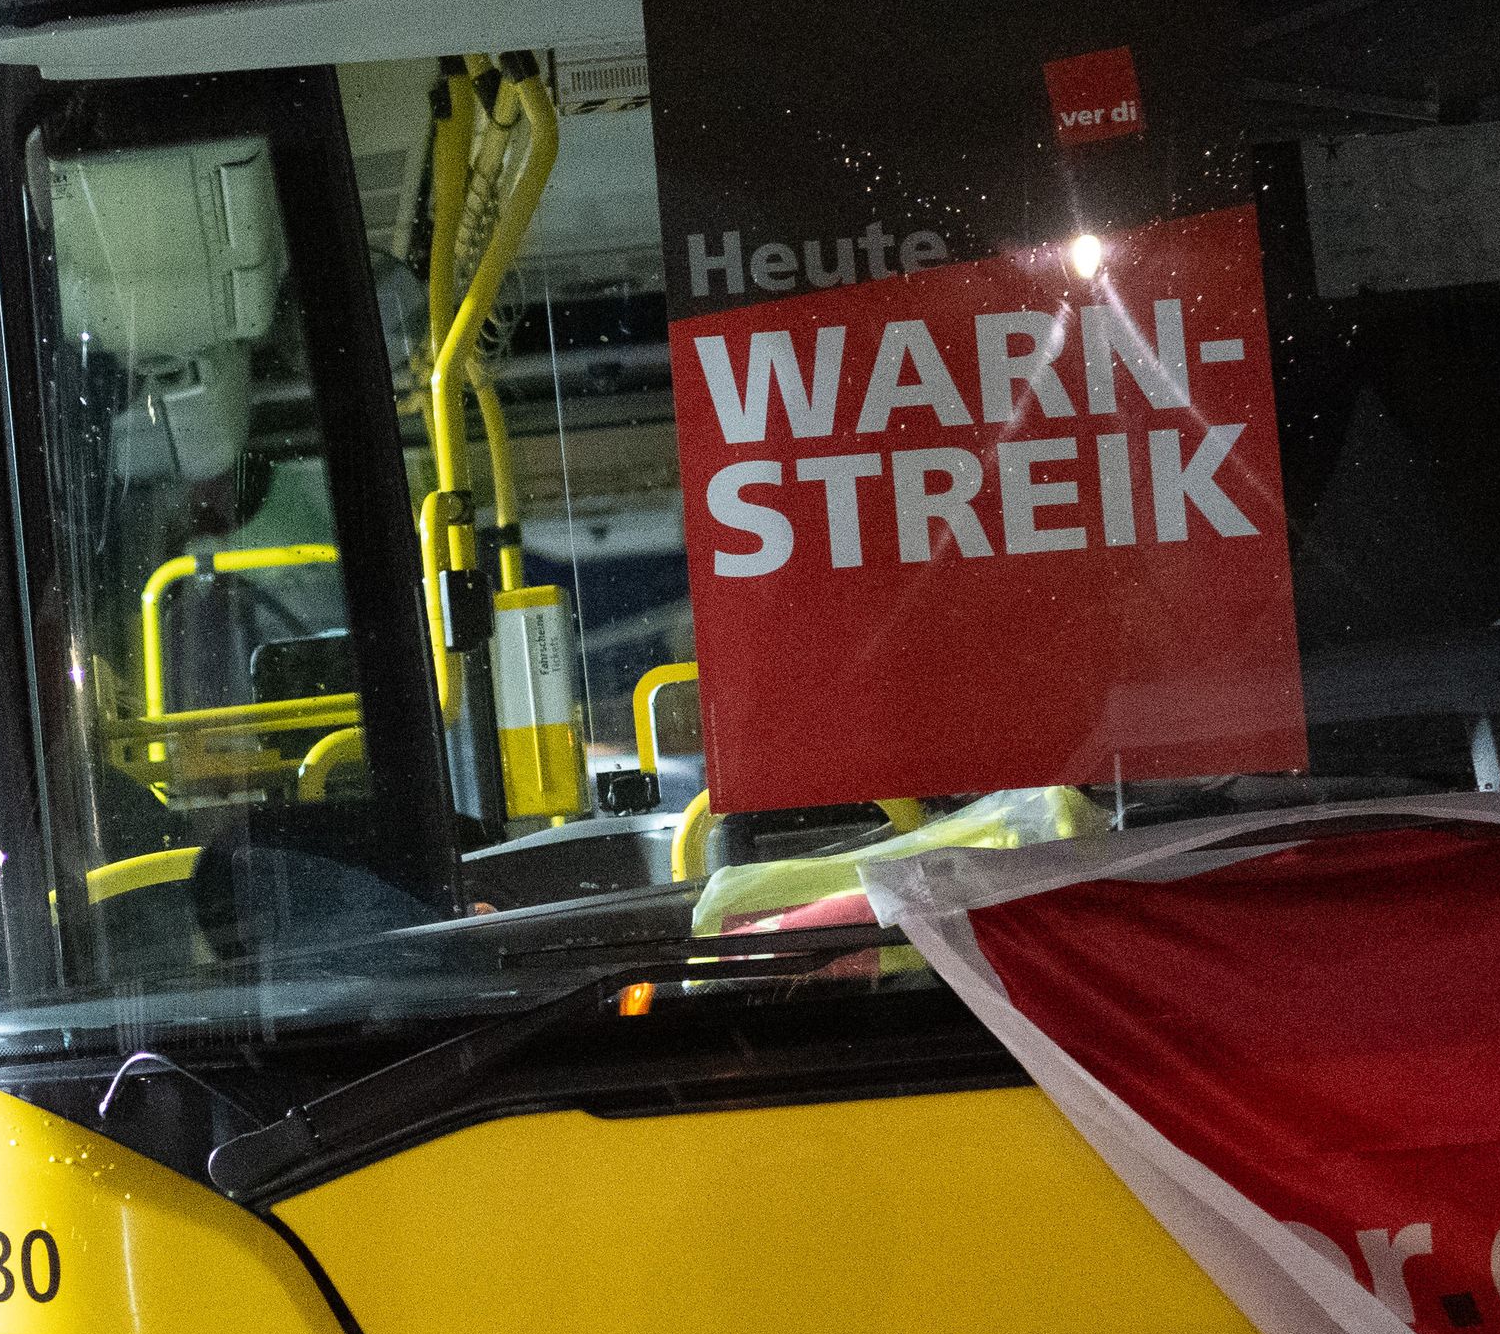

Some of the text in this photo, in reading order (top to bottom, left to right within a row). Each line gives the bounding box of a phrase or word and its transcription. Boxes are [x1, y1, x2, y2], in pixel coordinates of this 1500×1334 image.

[687, 220, 949, 299] Heute
[694, 298, 1245, 445] WARN-
[706, 423, 1261, 579] STREIK
